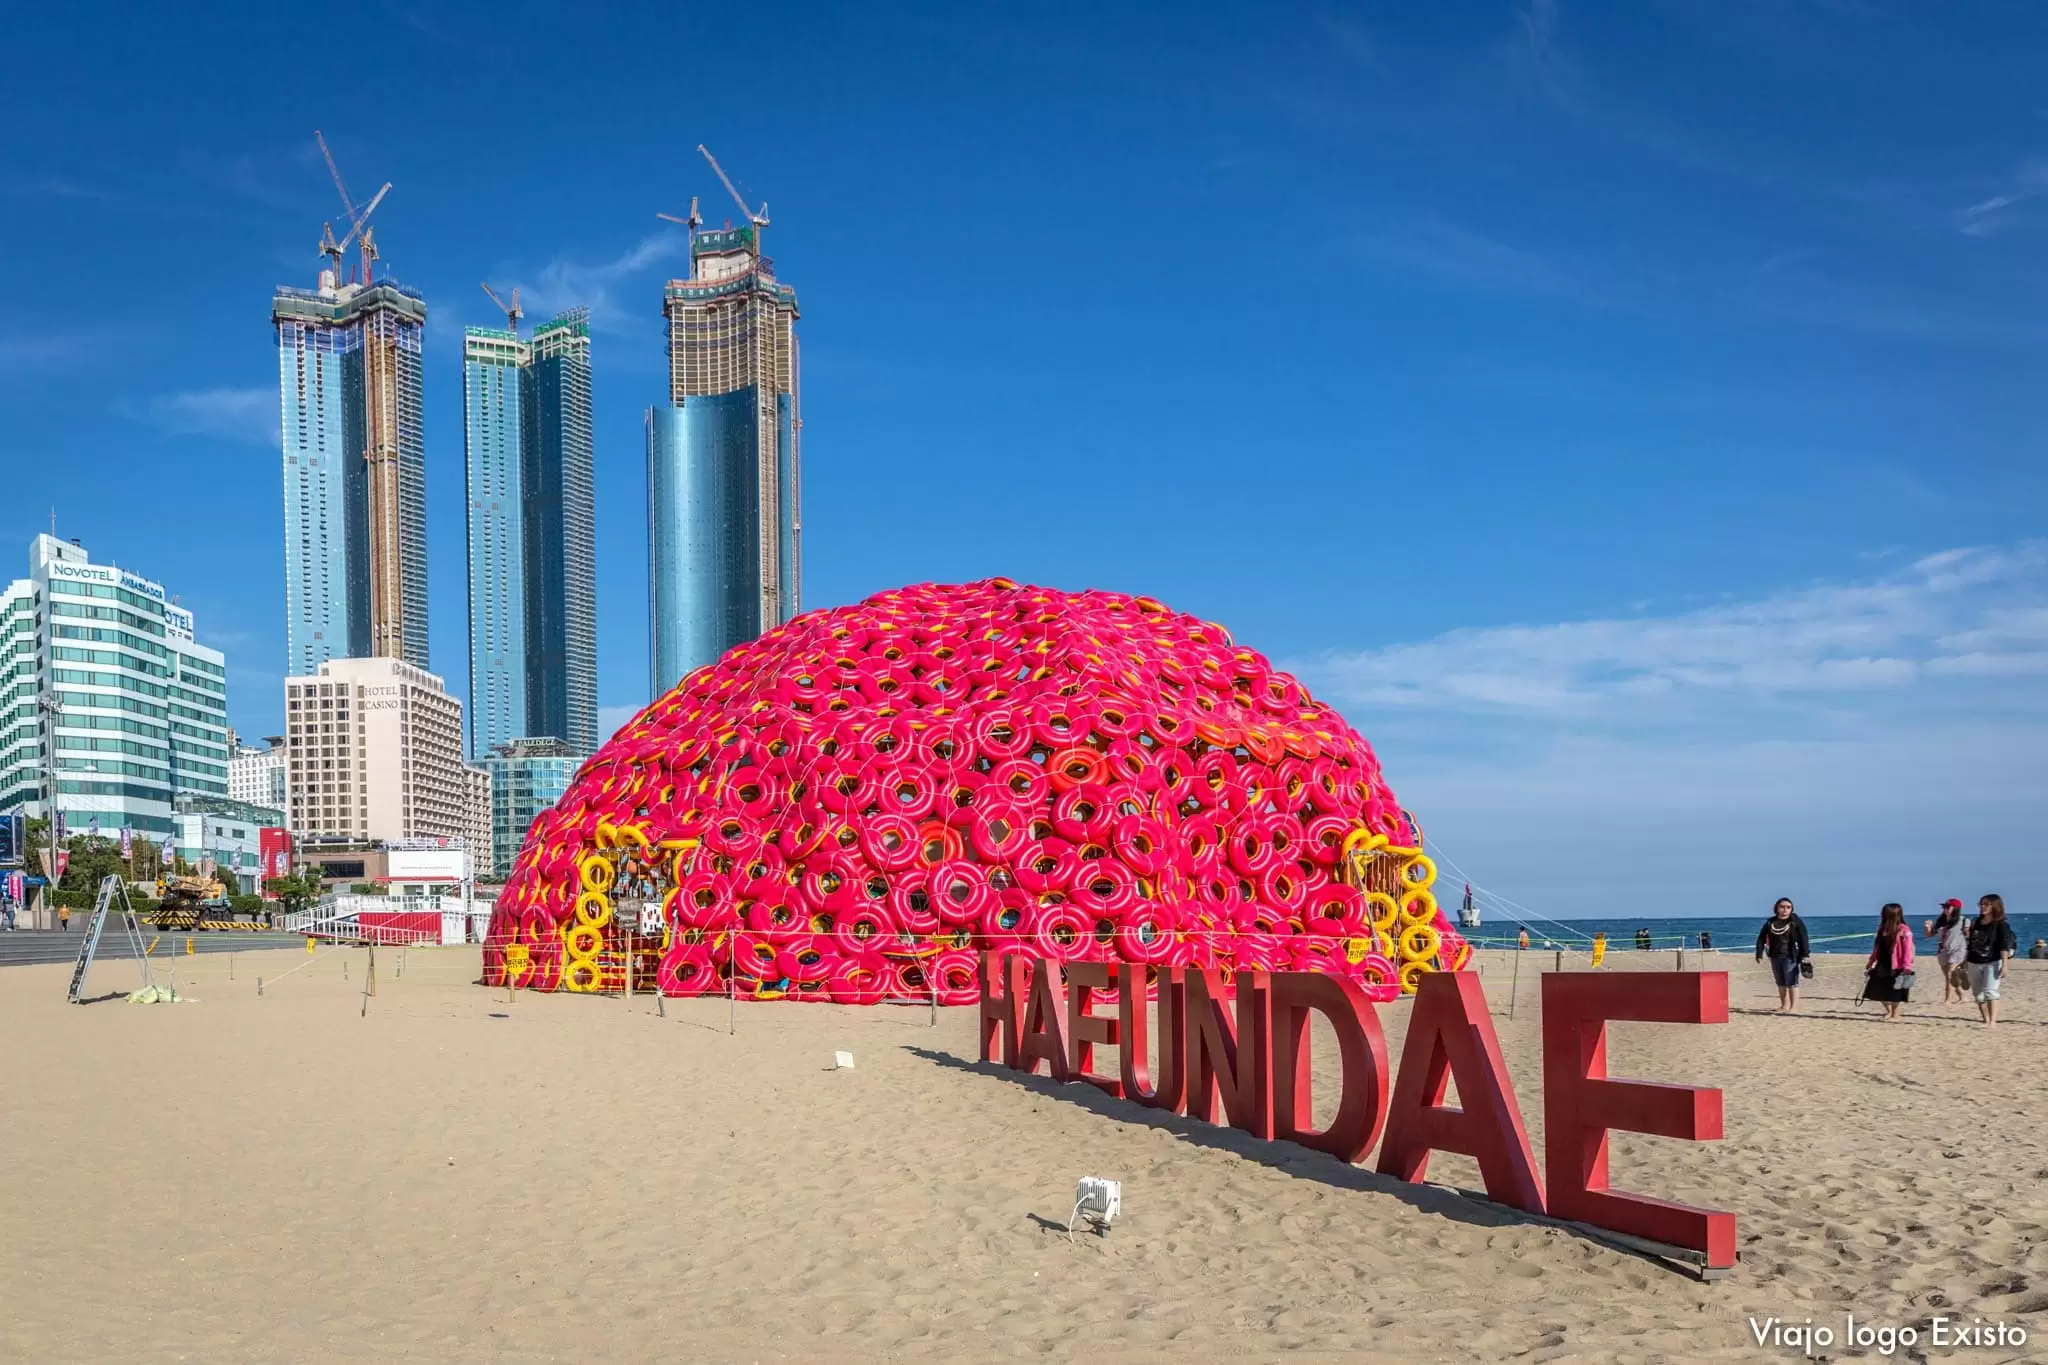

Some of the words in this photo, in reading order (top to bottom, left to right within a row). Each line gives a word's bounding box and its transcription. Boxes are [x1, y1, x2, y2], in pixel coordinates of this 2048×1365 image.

[54, 564, 114, 582] NOVOTEL
[164, 610, 193, 633] OTEL
[365, 686, 397, 696] HOTEL
[365, 700, 398, 709] CASINO
[980, 952, 1735, 1268] HAEUNDAE
